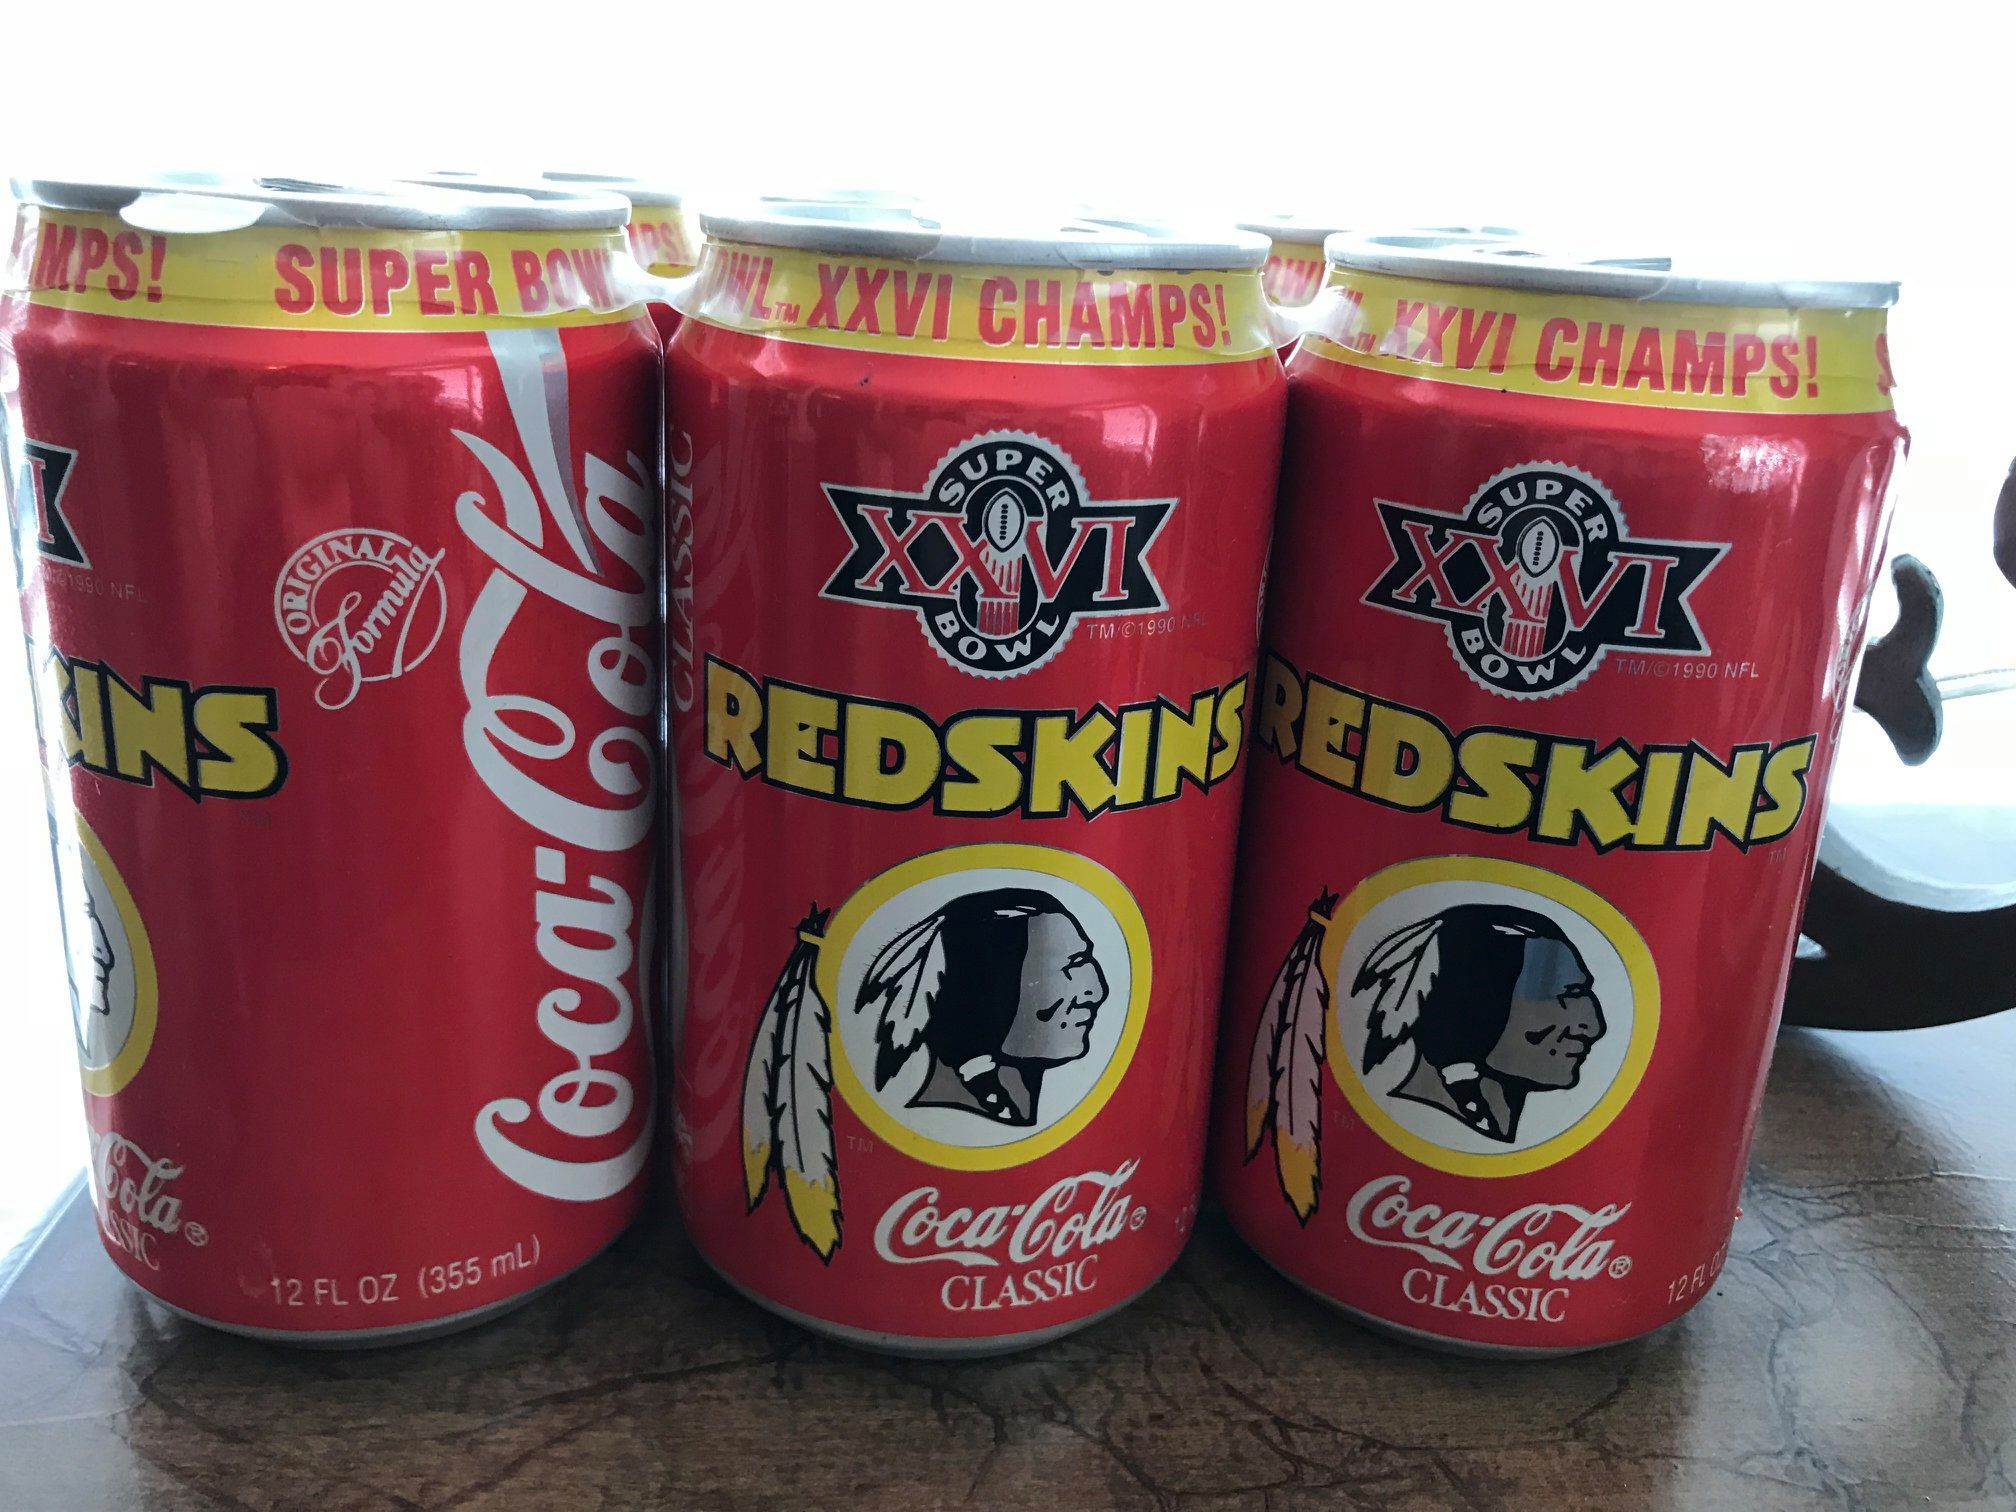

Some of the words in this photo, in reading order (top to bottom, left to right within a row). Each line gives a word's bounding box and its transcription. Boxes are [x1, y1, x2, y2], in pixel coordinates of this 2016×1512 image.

[275, 244, 500, 316] SUPER
[806, 263, 953, 343] XXVI
[978, 276, 1231, 349] CHAMPS!
[1384, 299, 1517, 375] XXVI
[1534, 316, 1818, 399] CHAMPS!
[939, 449, 1071, 512] SUPER
[1477, 479, 1609, 543] SUPER
[283, 536, 402, 635] ORIGINAL
[670, 429, 695, 712] CLASSIC
[854, 503, 1137, 604] XXVI
[1391, 519, 1679, 638] XXVI
[307, 545, 446, 711] Formula
[934, 609, 1060, 662] BOWL
[1461, 628, 1586, 685] BOWL
[1724, 659, 1760, 680] NFL
[703, 652, 1250, 823] REDSKINS
[1258, 648, 1818, 855] REDSKINS
[450, 428, 660, 1201] Coca-Cola
[270, 1277, 304, 1306] 12
[313, 1278, 349, 1306] FL
[358, 1272, 400, 1305] OZ
[417, 1255, 482, 1299] (355
[490, 1233, 541, 1278] mL)
[941, 1254, 1098, 1312] CLASSIC
[1402, 1267, 1570, 1323] CLASSIC
[1667, 1280, 1688, 1305] 12
[1690, 1263, 1706, 1294] FL
